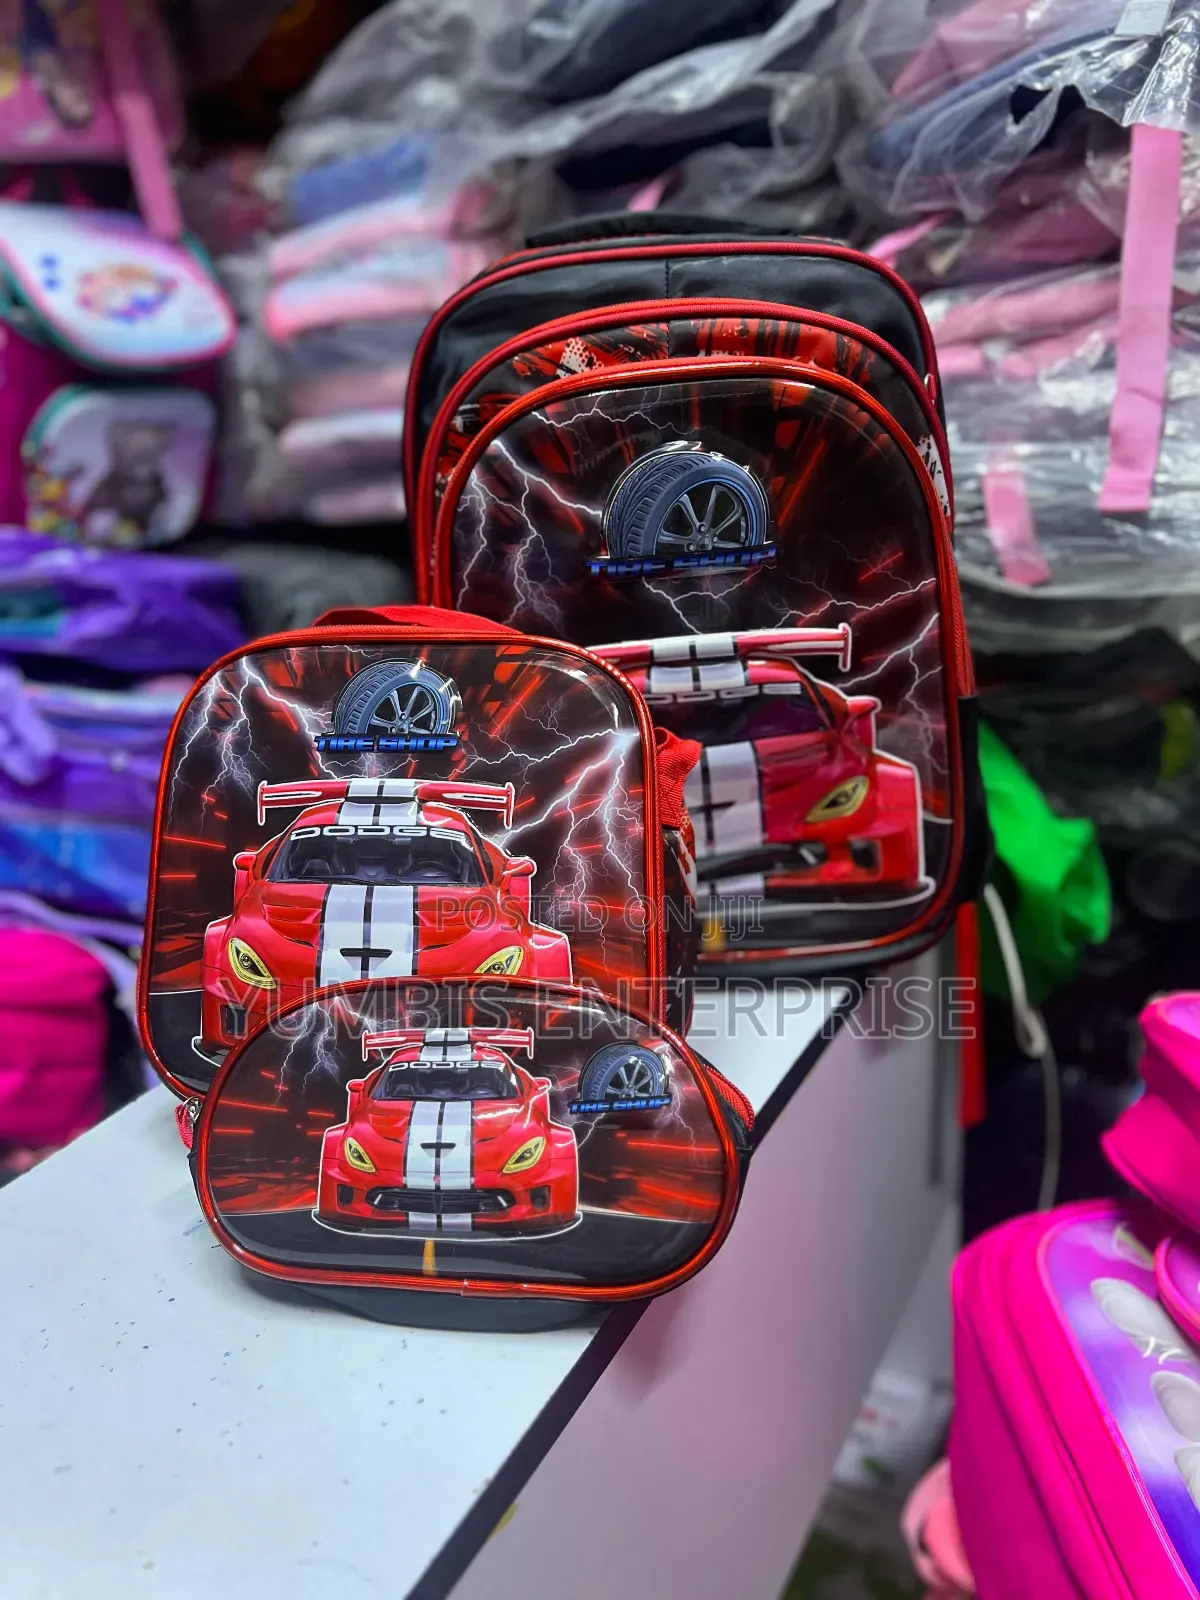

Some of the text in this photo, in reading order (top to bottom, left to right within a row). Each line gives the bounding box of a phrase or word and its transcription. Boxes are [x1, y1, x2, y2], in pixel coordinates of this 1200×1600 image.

[315, 736, 458, 751] TIRE SHOP
[290, 825, 467, 842] DODGE
[388, 1060, 506, 1072] DODGE
[570, 1097, 671, 1113] TIRE SHOP
